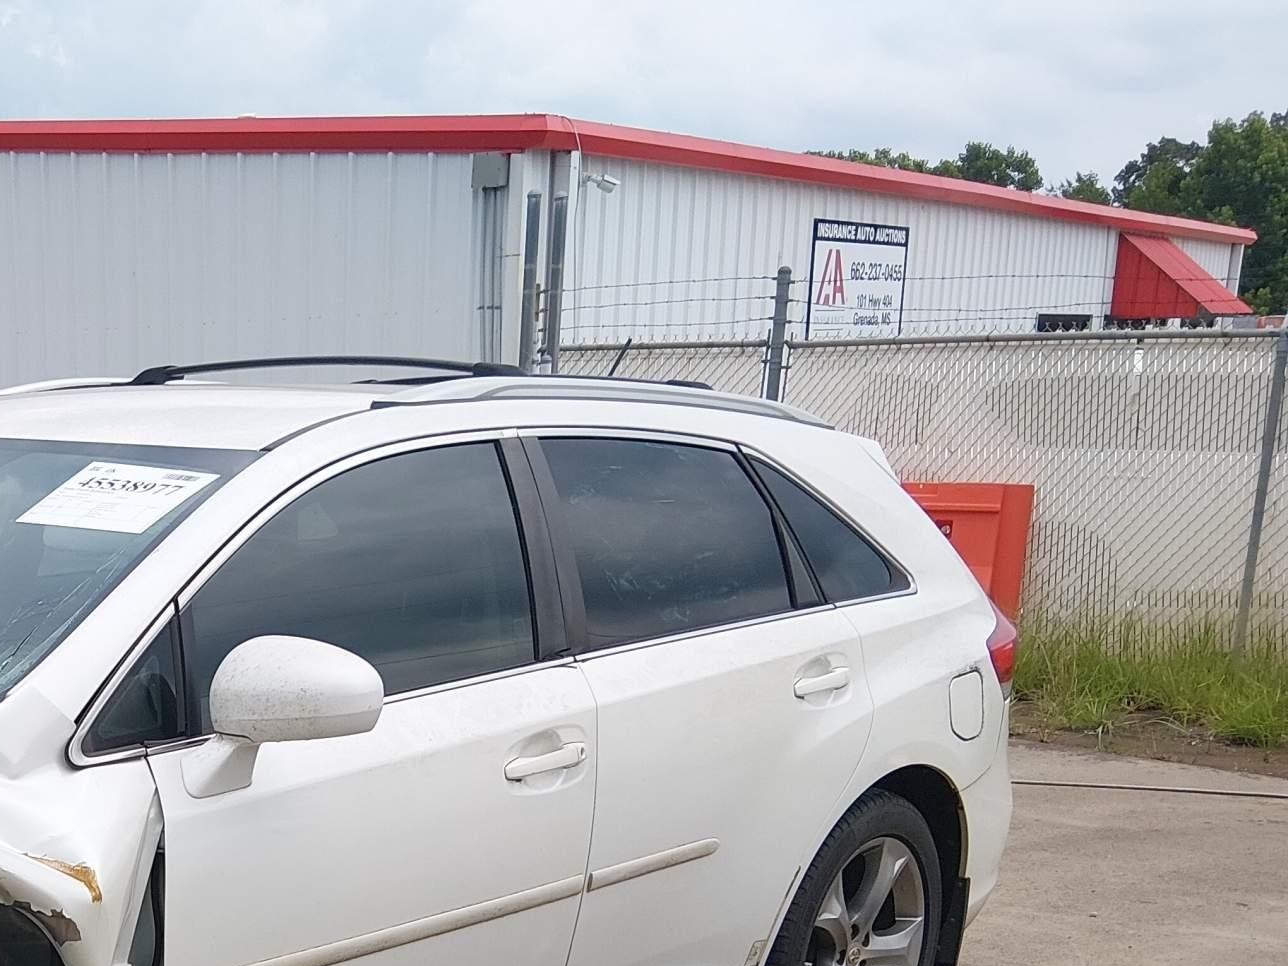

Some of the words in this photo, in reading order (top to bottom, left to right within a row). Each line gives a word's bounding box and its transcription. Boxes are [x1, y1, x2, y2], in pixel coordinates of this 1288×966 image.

[817, 223, 856, 239] INSURANCE
[856, 227, 875, 241] AUTO
[875, 229, 907, 244] AUCTIONS
[850, 262, 902, 281] 662-237-0455
[857, 294, 867, 308] 101
[868, 294, 881, 309] Hwy
[882, 294, 893, 308] 404
[853, 312, 880, 327] Grenada,
[881, 312, 891, 326] MS
[79, 476, 184, 496] 45538977
